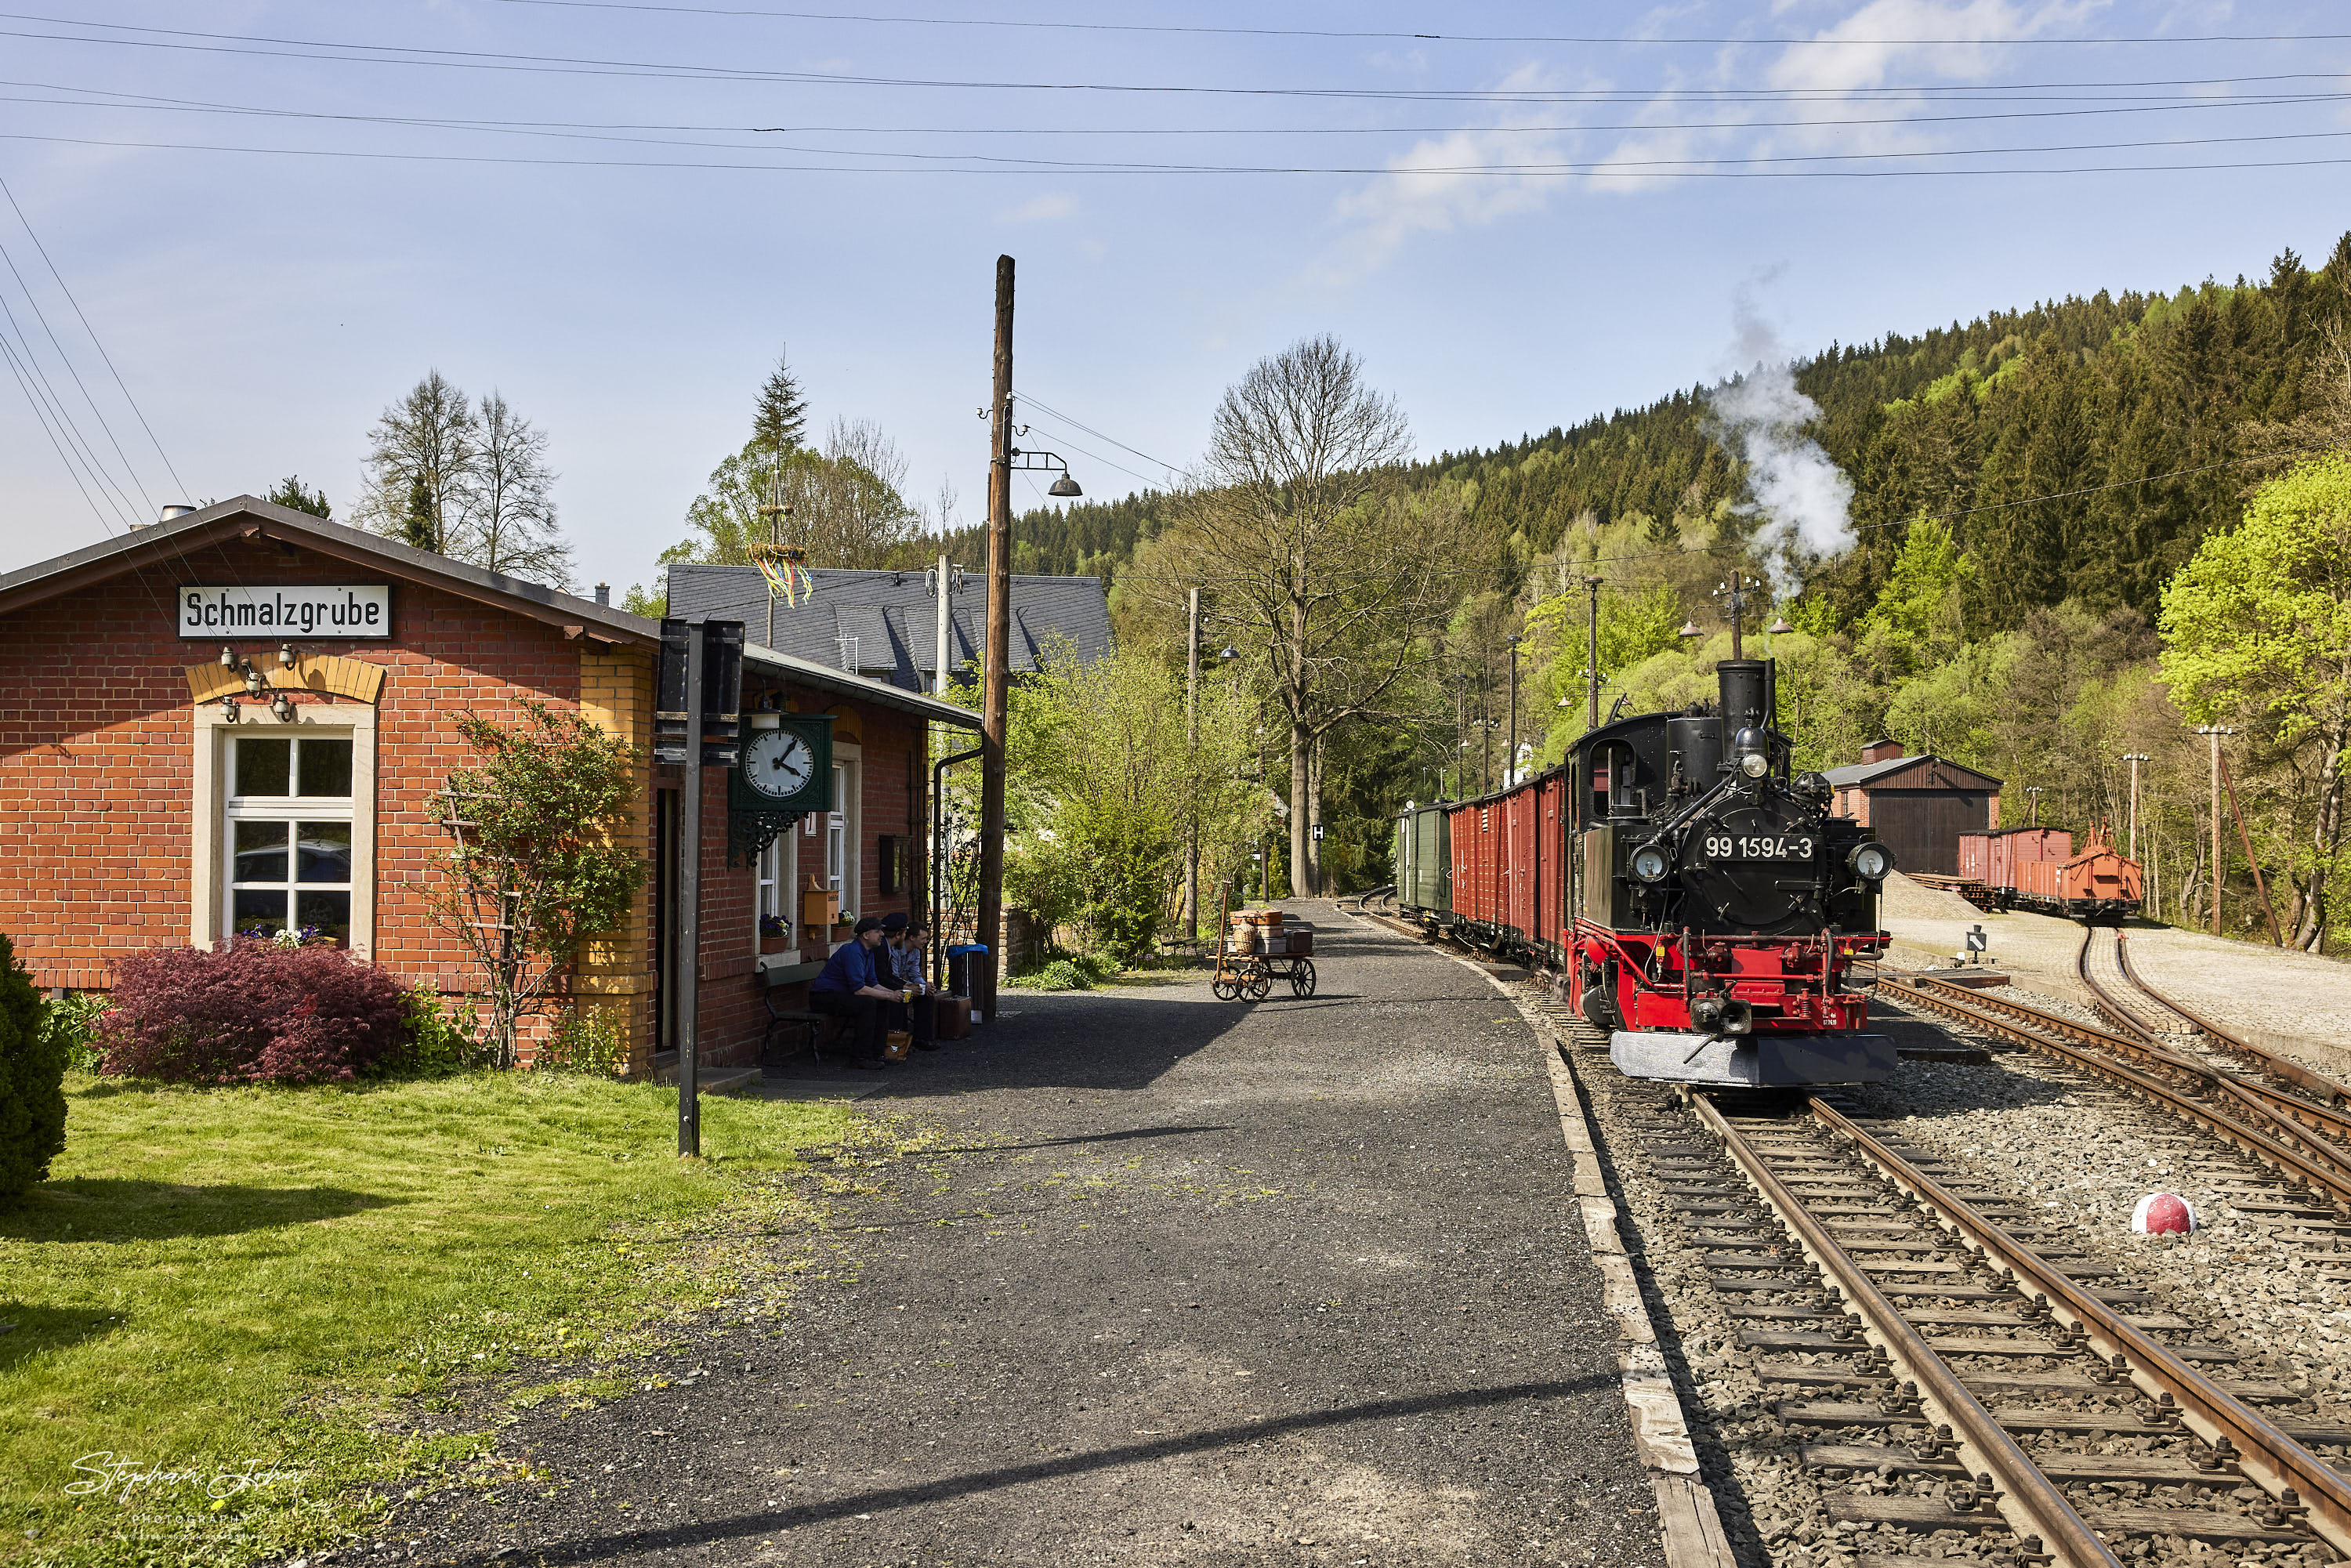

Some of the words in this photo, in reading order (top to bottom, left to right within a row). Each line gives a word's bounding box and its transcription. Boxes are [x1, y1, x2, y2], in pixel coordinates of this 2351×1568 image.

[187, 591, 380, 634] Schmalzgrube
[1313, 826, 1324, 839] H
[1706, 836, 1733, 857] 99
[1738, 837, 1813, 858] 1594-3
